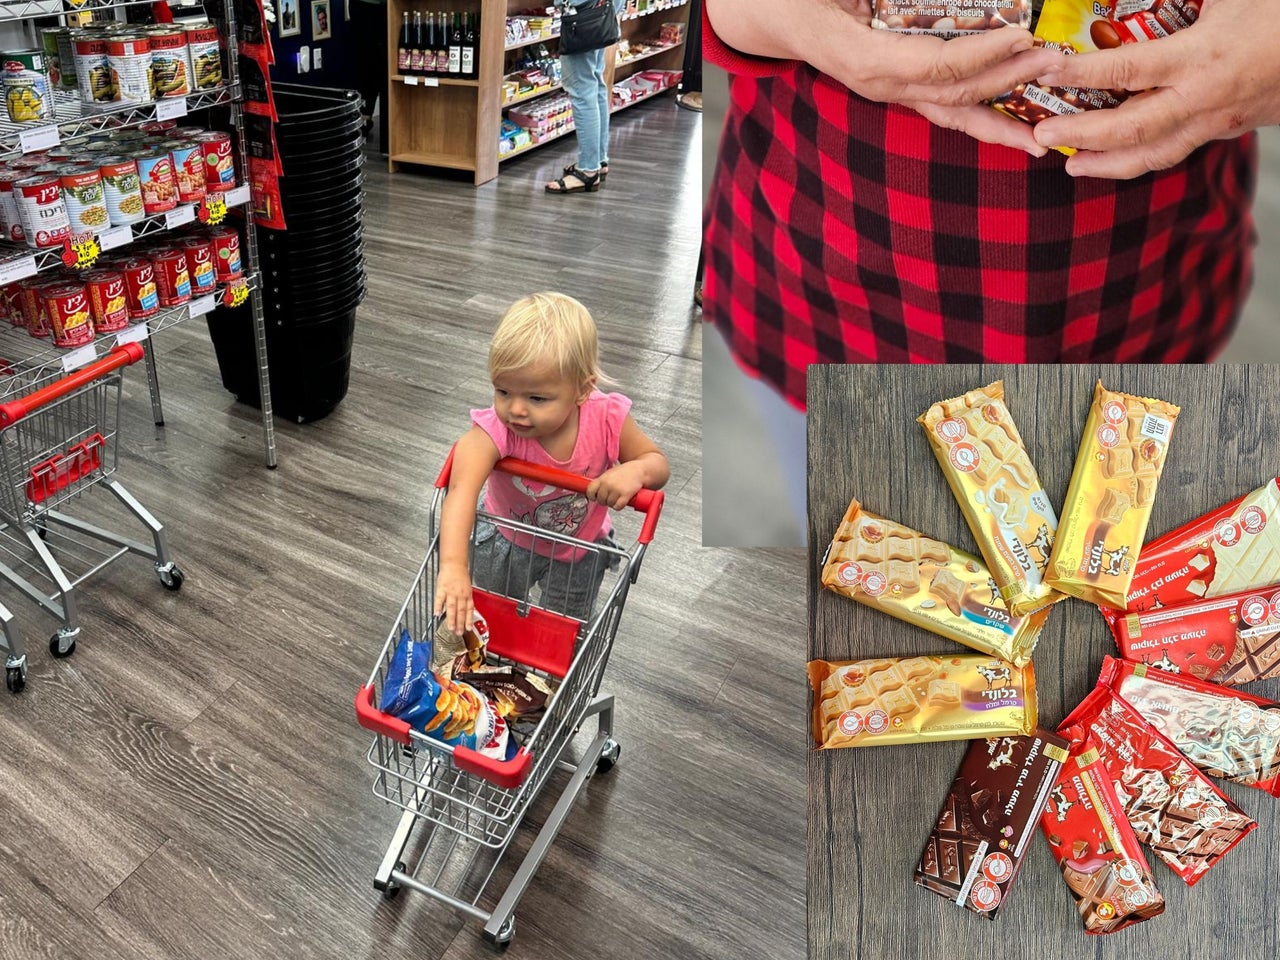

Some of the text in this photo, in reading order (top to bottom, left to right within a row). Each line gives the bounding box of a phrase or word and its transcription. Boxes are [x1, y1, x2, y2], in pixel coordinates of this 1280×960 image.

[899, 8, 985, 18] avec miettes biscuits
[974, 0, 1004, 9] chocolat
[1011, 537, 1032, 573] בלונדי
[1088, 540, 1104, 575] בלונדי
[1151, 566, 1190, 591] לבן מעולה
[983, 606, 1010, 623] בלונדי
[1130, 629, 1207, 651] שוקולד חלב מעולה
[981, 687, 1018, 701] בלונדי
[1004, 737, 1042, 816] שוקולד מריר מעולה
